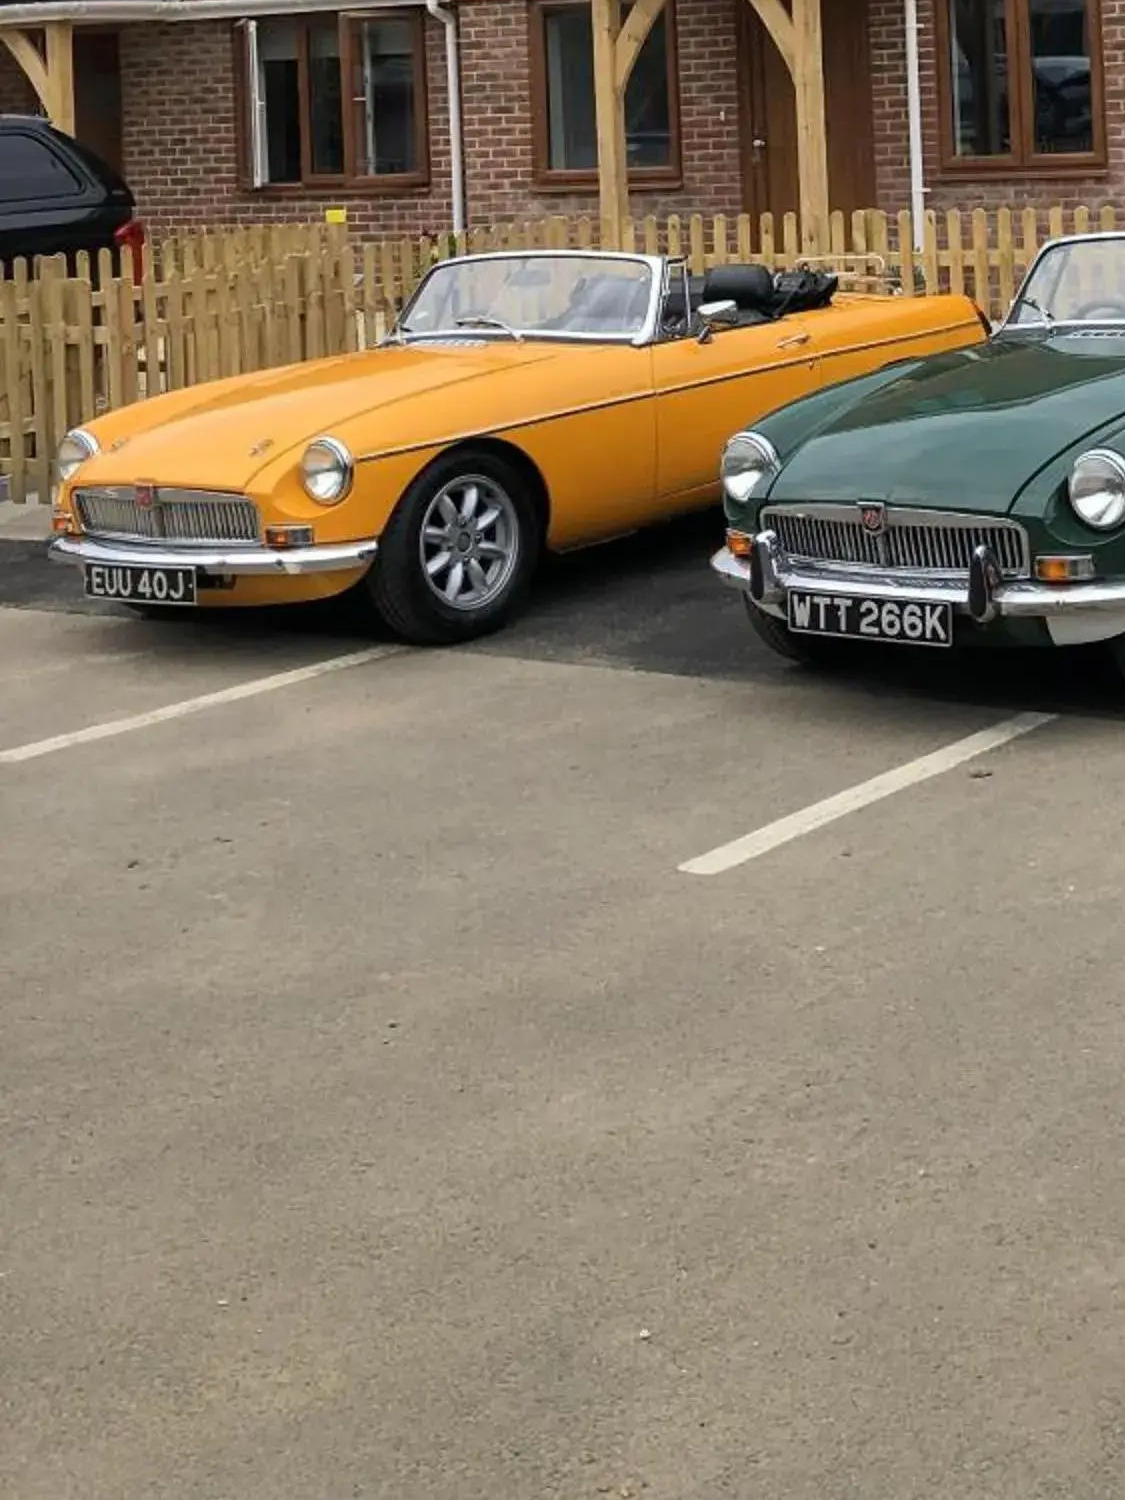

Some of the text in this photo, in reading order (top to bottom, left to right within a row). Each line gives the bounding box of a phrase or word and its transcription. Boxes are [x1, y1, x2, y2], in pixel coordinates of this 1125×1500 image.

[91, 566, 185, 599] EUU 40J
[792, 593, 947, 640] WTT 266K
